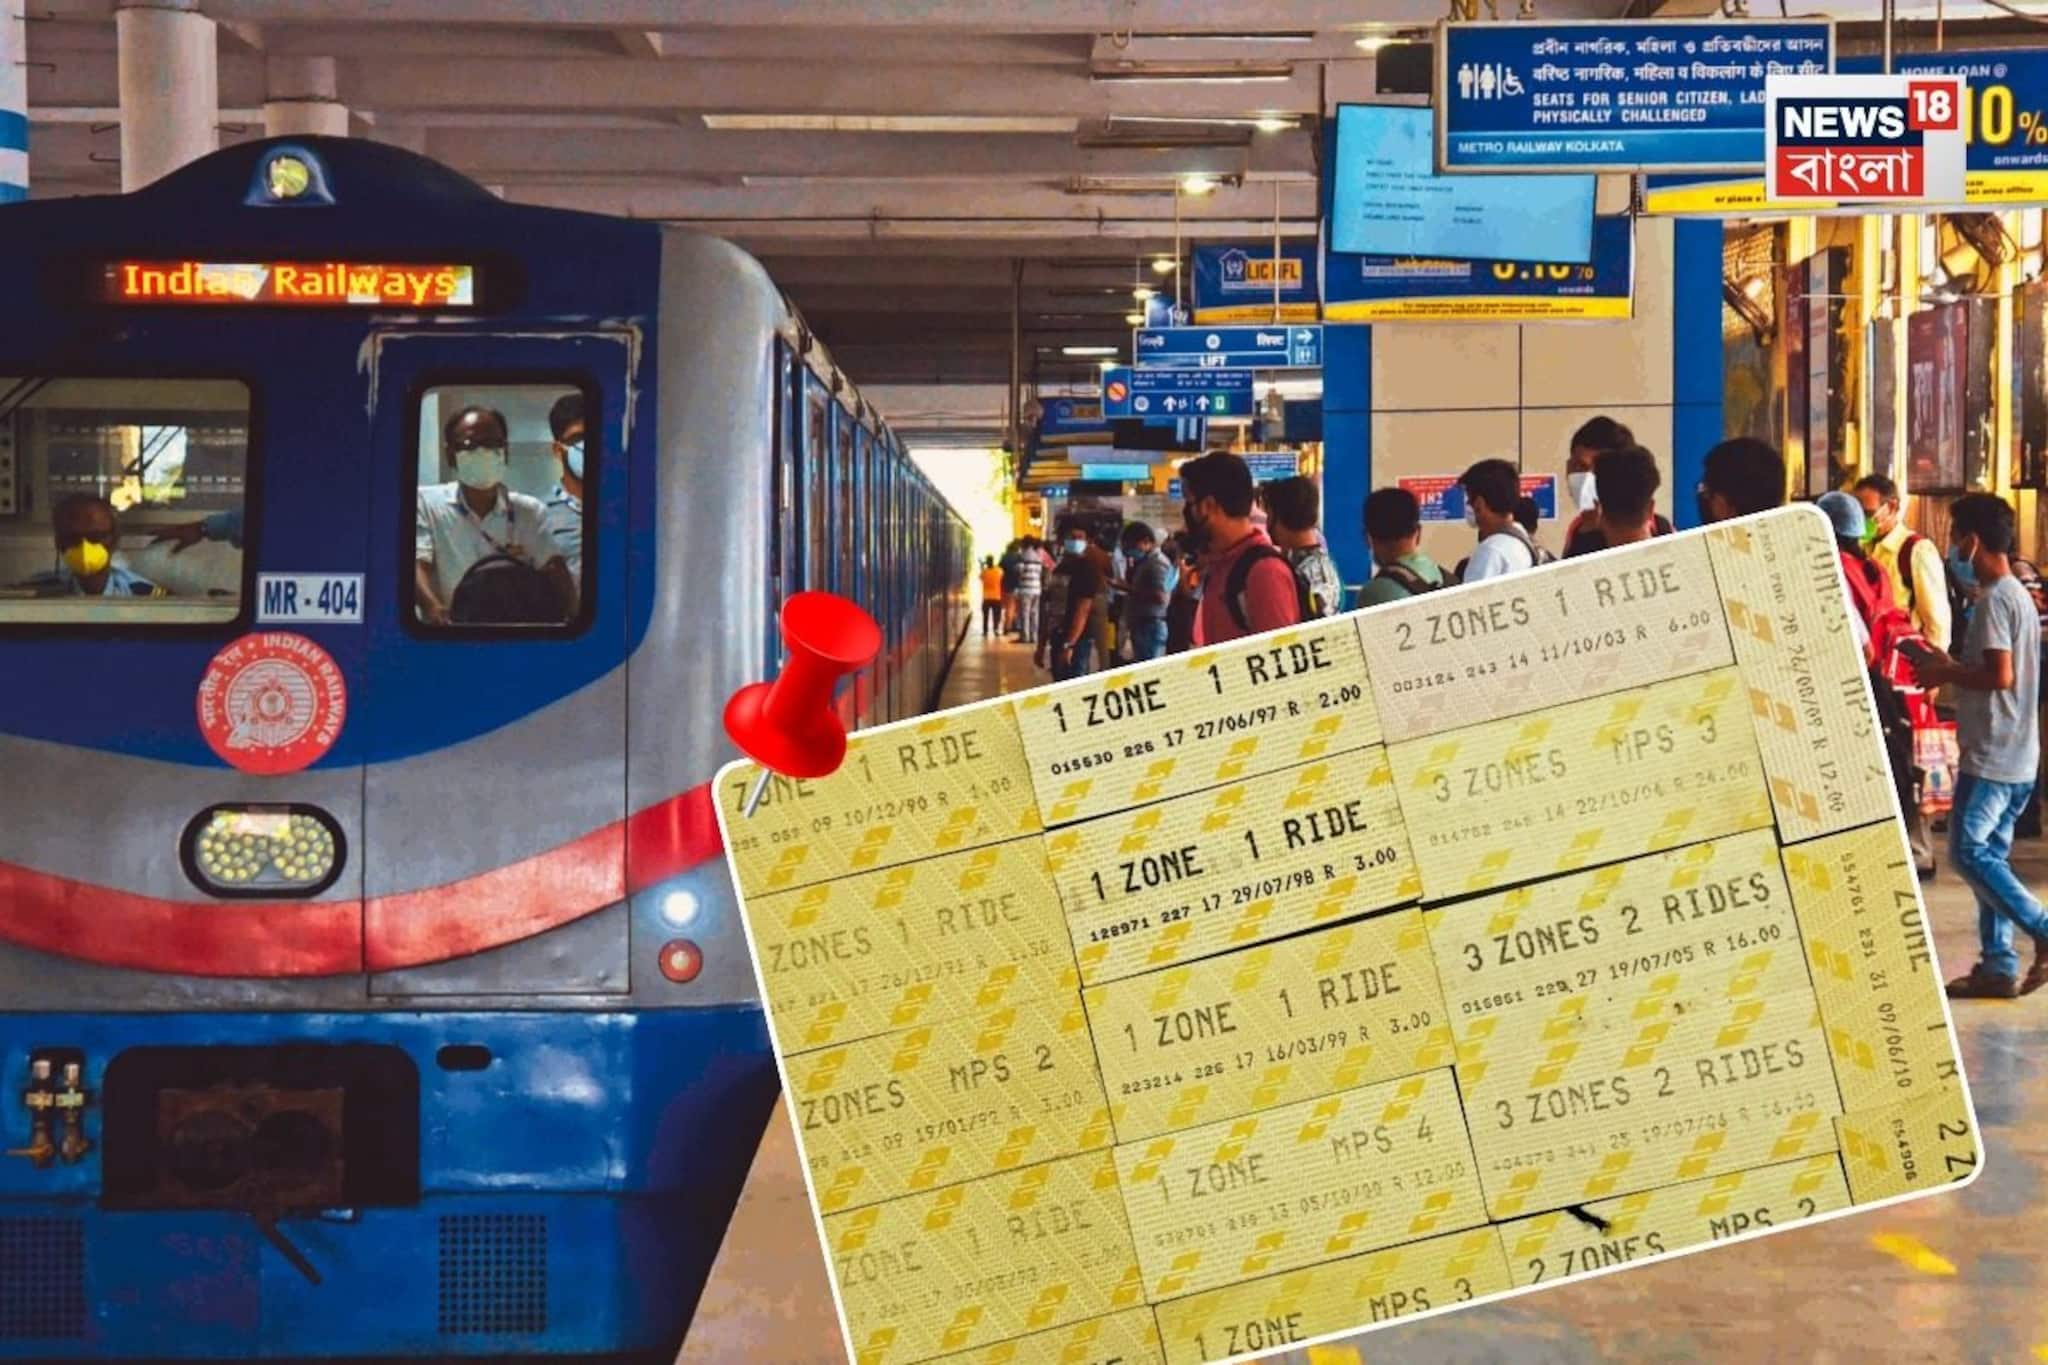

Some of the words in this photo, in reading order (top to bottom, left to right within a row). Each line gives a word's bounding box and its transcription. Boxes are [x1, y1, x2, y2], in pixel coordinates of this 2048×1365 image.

[1634, 61, 1674, 80] महिला
[1637, 37, 1677, 54] মহিলা
[1683, 41, 1696, 54] ও
[1786, 37, 1824, 53] আসন
[1533, 92, 1575, 106] SEATS
[1583, 91, 1610, 106] FOR
[1618, 91, 1668, 105] SENIOR
[1675, 90, 1732, 105] CITIZEN,
[1533, 109, 1611, 123] PHYSICALLY
[1621, 108, 1707, 122] CHALLENGED
[1458, 141, 1502, 153] METRO
[1507, 140, 1562, 153] RAILWAY
[1566, 139, 1625, 152] KOLKATA
[124, 262, 261, 296] Indian
[274, 262, 456, 305] Railways
[1247, 263, 1269, 280] LIC
[1200, 354, 1228, 367] LIFT
[264, 580, 298, 616] MR
[317, 580, 358, 616] 404
[1395, 620, 1416, 652] 2
[1426, 596, 1531, 646] ZONES
[1553, 588, 1569, 618] 1
[1594, 562, 1682, 609] RIDE
[1508, 651, 1530, 670] 14
[1540, 627, 1626, 662] 11/10/03
[1636, 625, 1648, 641] R
[1668, 610, 1712, 635] 6.00
[263, 634, 323, 665] INDIAN
[317, 662, 344, 746] RAILWAYS
[1052, 702, 1070, 733] 1
[1082, 678, 1167, 728] ZONE
[1207, 663, 1223, 695] 1
[1246, 636, 1333, 686] RIDE
[1123, 740, 1155, 758] 226
[1164, 729, 1185, 748] 17
[1194, 705, 1278, 740] 27/06/97
[1288, 700, 1301, 716] R
[1318, 683, 1363, 710] 2.00
[858, 753, 874, 783] 1
[898, 728, 984, 774] RIDE
[1432, 772, 1452, 803] 3
[1462, 748, 1569, 798] ZONES
[1612, 723, 1676, 766] MPS
[1699, 713, 1719, 746] 3
[812, 815, 832, 833] 09
[844, 795, 929, 826] 10/12/90
[1090, 869, 1106, 902] 1
[1119, 844, 1204, 894] ZONE
[1244, 828, 1260, 860] 1
[1283, 798, 1368, 849] RIDE
[1090, 915, 1150, 943] 128971
[1160, 904, 1191, 923] 227
[1201, 894, 1222, 913] 17
[1231, 871, 1316, 905] 29/07/98
[1322, 864, 1336, 880] R
[1353, 846, 1398, 873] 3.00
[1463, 943, 1484, 973] 3
[1493, 914, 1601, 967] ZONES
[1620, 905, 1644, 937] 2
[1663, 871, 1772, 926] RIDES
[769, 926, 874, 974] ZONES
[937, 893, 1024, 938] RIDE
[1576, 969, 1598, 988] 27
[1609, 946, 1696, 980] 19/07/05
[1703, 940, 1717, 957] R
[1726, 922, 1783, 953] 16.00
[1123, 1023, 1139, 1053] 1
[1153, 1000, 1239, 1048] ZONE
[1278, 986, 1293, 1019] 1
[1317, 961, 1402, 1010] RIDE
[1121, 1073, 1185, 1097] 223214
[1234, 1051, 1255, 1072] 17
[1266, 1029, 1349, 1063] 16/03/99
[1358, 1025, 1371, 1042] R
[1389, 1010, 1433, 1036] 3.00
[1495, 1100, 1515, 1130] 3
[1526, 1075, 1632, 1126] ZONES
[1653, 1067, 1676, 1098] 2
[1696, 1039, 1806, 1090] RIDES
[801, 1079, 907, 1132] ZONES
[949, 1054, 1013, 1095] MPS
[1033, 1044, 1055, 1074] 2
[1187, 1153, 1270, 1201] ZONE
[1330, 1124, 1394, 1168] MPS
[1415, 1114, 1436, 1145] 4
[1938, 1119, 1970, 1142] 2
[1945, 1150, 1978, 1183] Z
[1006, 1206, 1094, 1247] RIDE
[1222, 1312, 1309, 1358] ZONE
[1369, 1286, 1432, 1323] MPS
